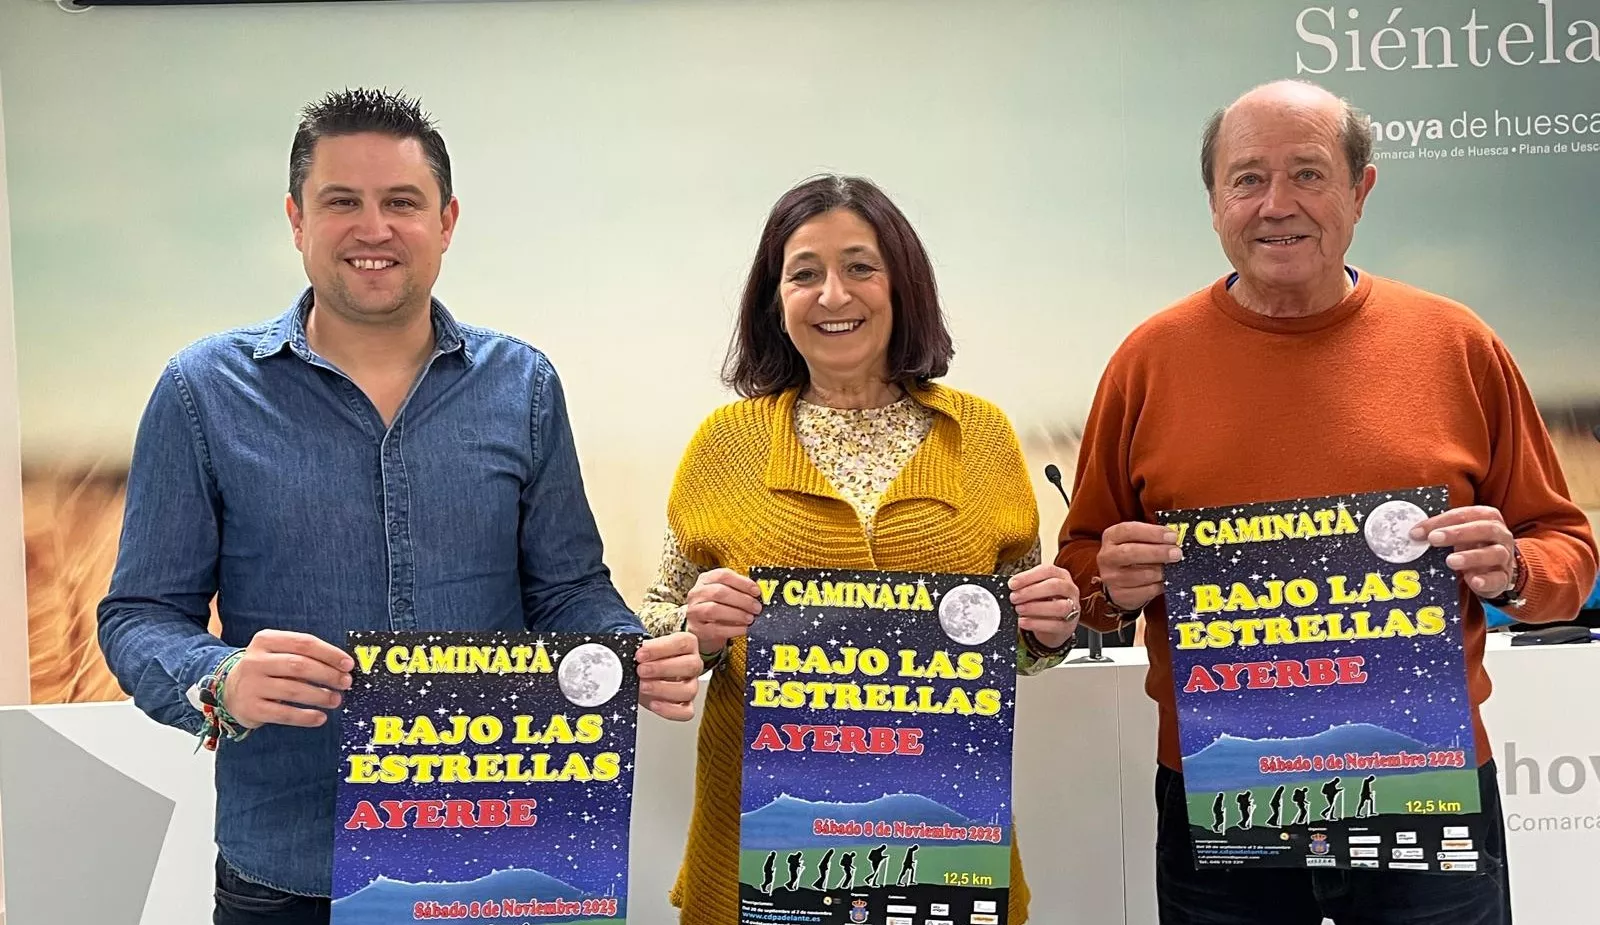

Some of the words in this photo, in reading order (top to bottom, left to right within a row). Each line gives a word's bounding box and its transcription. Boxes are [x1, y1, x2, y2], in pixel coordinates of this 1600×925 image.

[1295, 0, 1600, 74] Siéntela
[1367, 115, 1443, 147] hoya
[1450, 110, 1487, 138] de
[1495, 109, 1600, 136] huesca
[1373, 151, 1415, 160] omarca
[1418, 148, 1447, 159] Hoya
[1450, 147, 1465, 157] de
[1468, 145, 1508, 157] Huesca
[1519, 143, 1550, 154] Plana
[1553, 142, 1568, 153] de
[1570, 141, 1600, 152] Uesc
[1195, 509, 1359, 546] CAMINATA
[757, 579, 779, 605] V
[783, 580, 934, 611] CAMINATA
[1192, 577, 1318, 613] BAJO
[1327, 570, 1422, 604] LAS
[1175, 606, 1446, 649] ESTRELLAS
[354, 646, 381, 673] V
[385, 645, 553, 674] CAMINATA
[772, 644, 889, 676] BAJO
[897, 649, 984, 680] LAS
[1184, 656, 1368, 692] AYERBE
[750, 680, 1002, 716] ESTRELLAS
[372, 714, 503, 745] BAJO
[512, 714, 604, 744] LAS
[751, 723, 924, 756] AYERBE
[345, 752, 621, 784] ESTRELLAS
[1259, 756, 1312, 773] Sábado
[1312, 754, 1324, 771] 8
[1325, 753, 1344, 770] de
[1344, 751, 1426, 770] Noviembre
[1427, 751, 1465, 768] 2025
[344, 798, 537, 829] AYERBE
[1406, 801, 1436, 815] 12,5
[1438, 800, 1461, 812] km
[813, 819, 862, 837] Sábado
[863, 822, 874, 836] 8
[875, 821, 893, 837] de
[891, 821, 967, 840] Noviembre
[968, 826, 1002, 843] 2025
[943, 872, 969, 887] 12,5
[972, 873, 992, 886] km
[413, 901, 468, 920] Sábado
[469, 901, 481, 918] 8
[481, 899, 500, 918] de
[501, 898, 580, 918] Noviembre
[581, 898, 618, 916] 2025
[742, 911, 821, 922] www.cdpadelante.es
